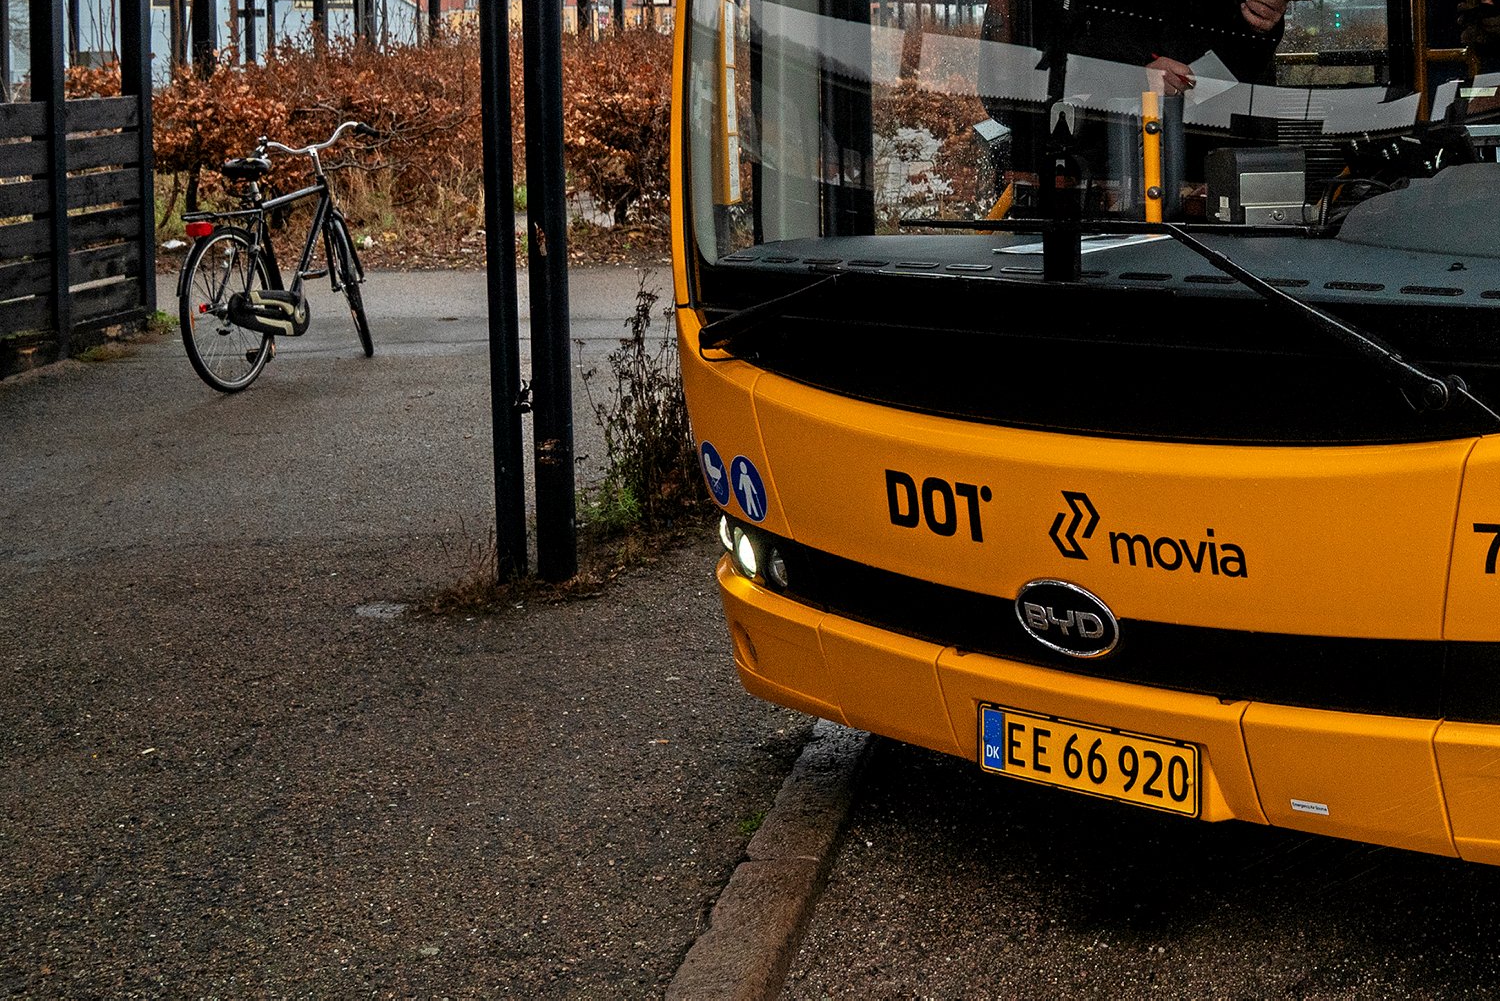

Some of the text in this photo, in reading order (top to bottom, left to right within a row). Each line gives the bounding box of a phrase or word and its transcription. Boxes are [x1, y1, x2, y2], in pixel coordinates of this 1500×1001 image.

[885, 469, 992, 543] DOT
[1109, 528, 1248, 578] movia
[1024, 602, 1104, 639] BYD
[986, 721, 1189, 802] DK EE 66 920
